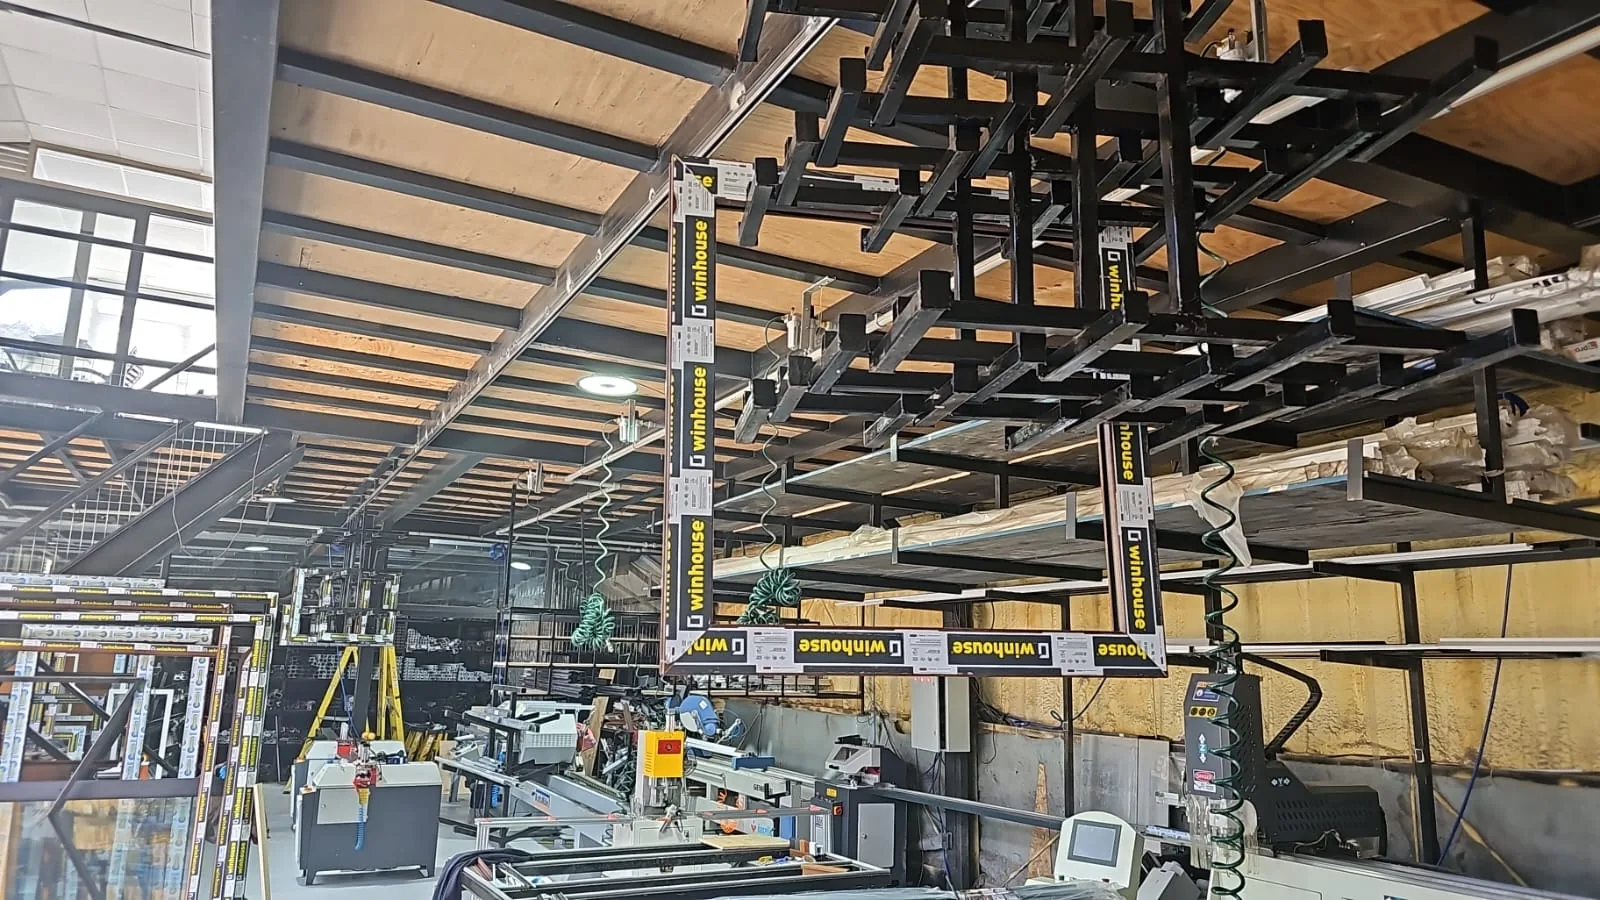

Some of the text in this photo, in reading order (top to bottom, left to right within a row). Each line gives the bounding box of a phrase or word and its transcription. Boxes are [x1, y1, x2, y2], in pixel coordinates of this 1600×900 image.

[692, 221, 707, 301] winhouse
[690, 367, 707, 451] winhouse
[688, 520, 705, 611] winhouse
[1128, 545, 1146, 630] winhouse
[799, 638, 886, 656] winhouse
[952, 641, 1034, 658] winhouse
